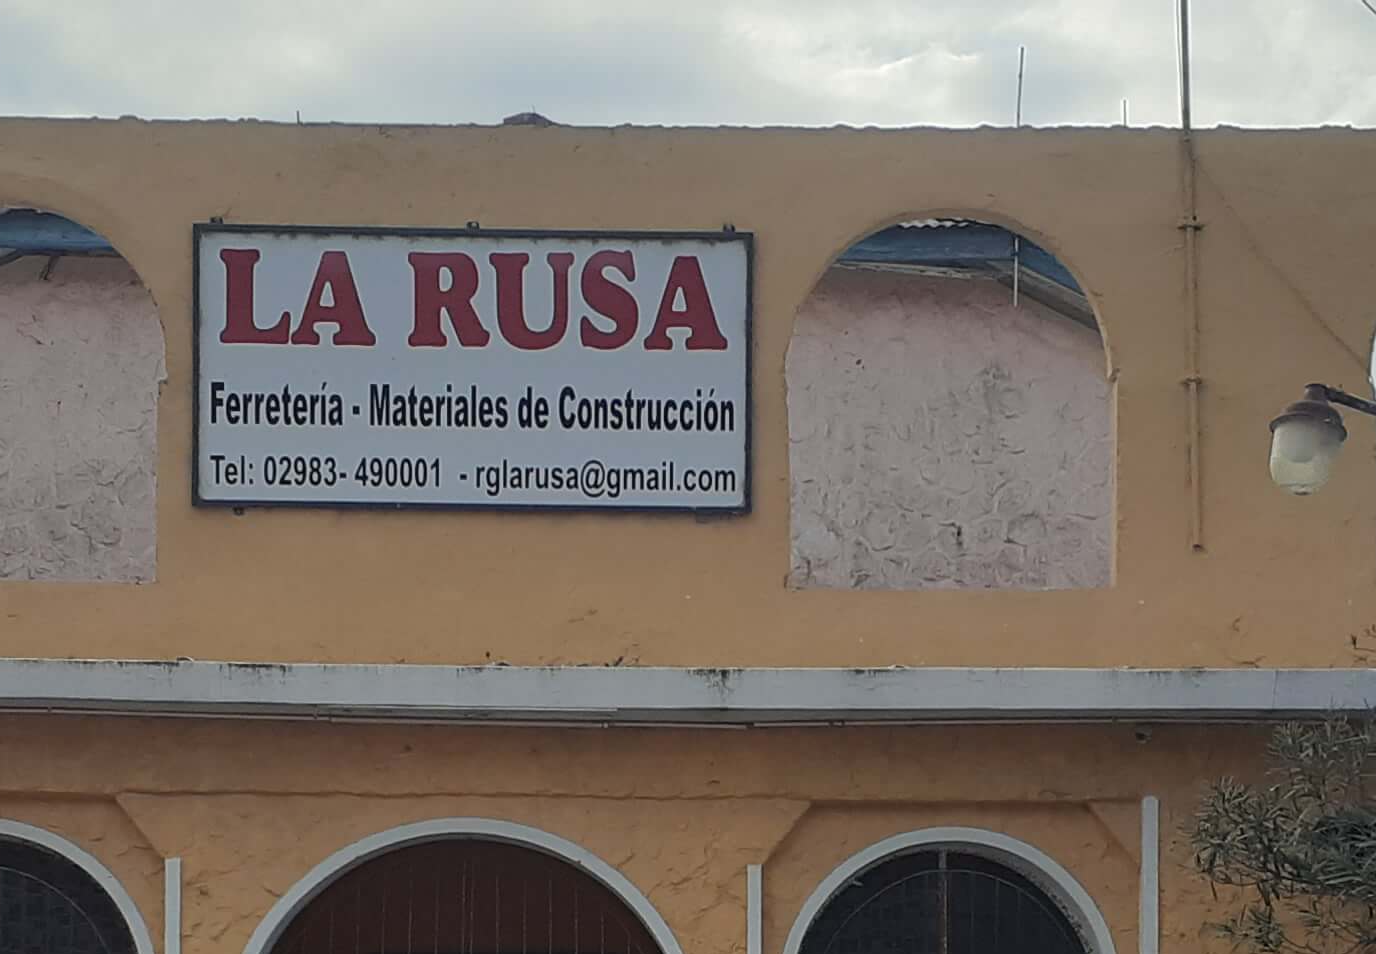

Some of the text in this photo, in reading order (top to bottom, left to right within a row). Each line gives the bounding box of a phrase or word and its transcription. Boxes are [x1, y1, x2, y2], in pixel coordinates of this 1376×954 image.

[219, 248, 729, 352] LA RUSA
[210, 381, 343, 427] Ferretería
[369, 383, 509, 429] Materiales
[517, 386, 549, 430] de
[558, 386, 735, 433] Construcción
[209, 455, 254, 486] Tel:
[263, 455, 348, 486] 02983-
[354, 457, 441, 489] 490001
[475, 460, 737, 499] rglarusa@gmail.com
